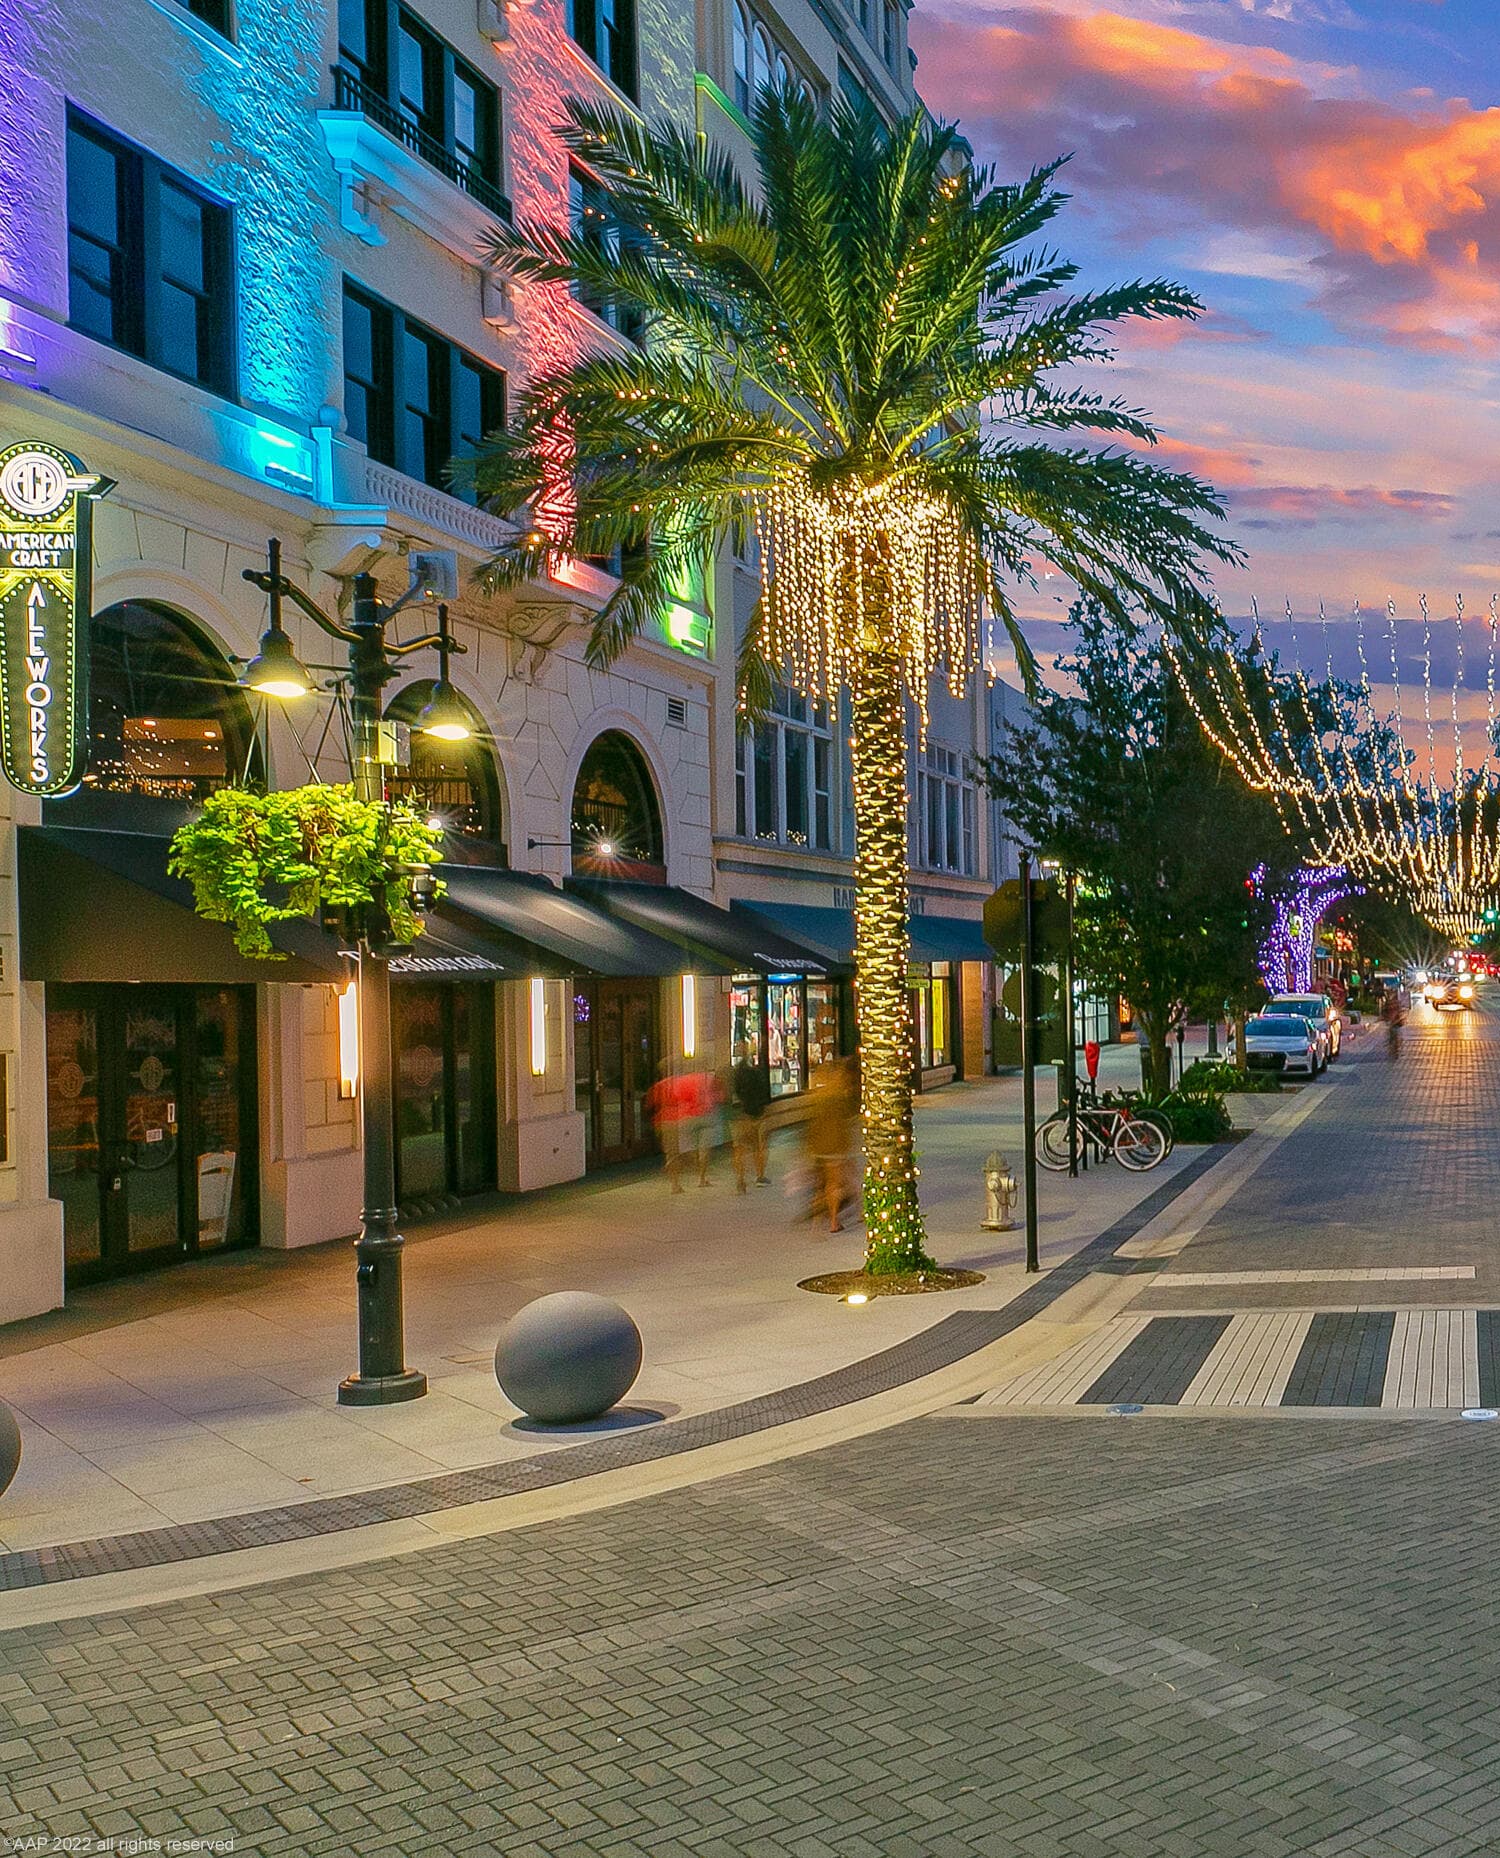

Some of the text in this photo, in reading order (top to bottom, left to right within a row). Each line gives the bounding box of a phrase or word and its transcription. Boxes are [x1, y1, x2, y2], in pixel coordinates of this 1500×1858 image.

[0, 533, 75, 550] AMERICAN
[10, 550, 60, 567] CRAFT
[25, 581, 52, 783] ALEWORKS
